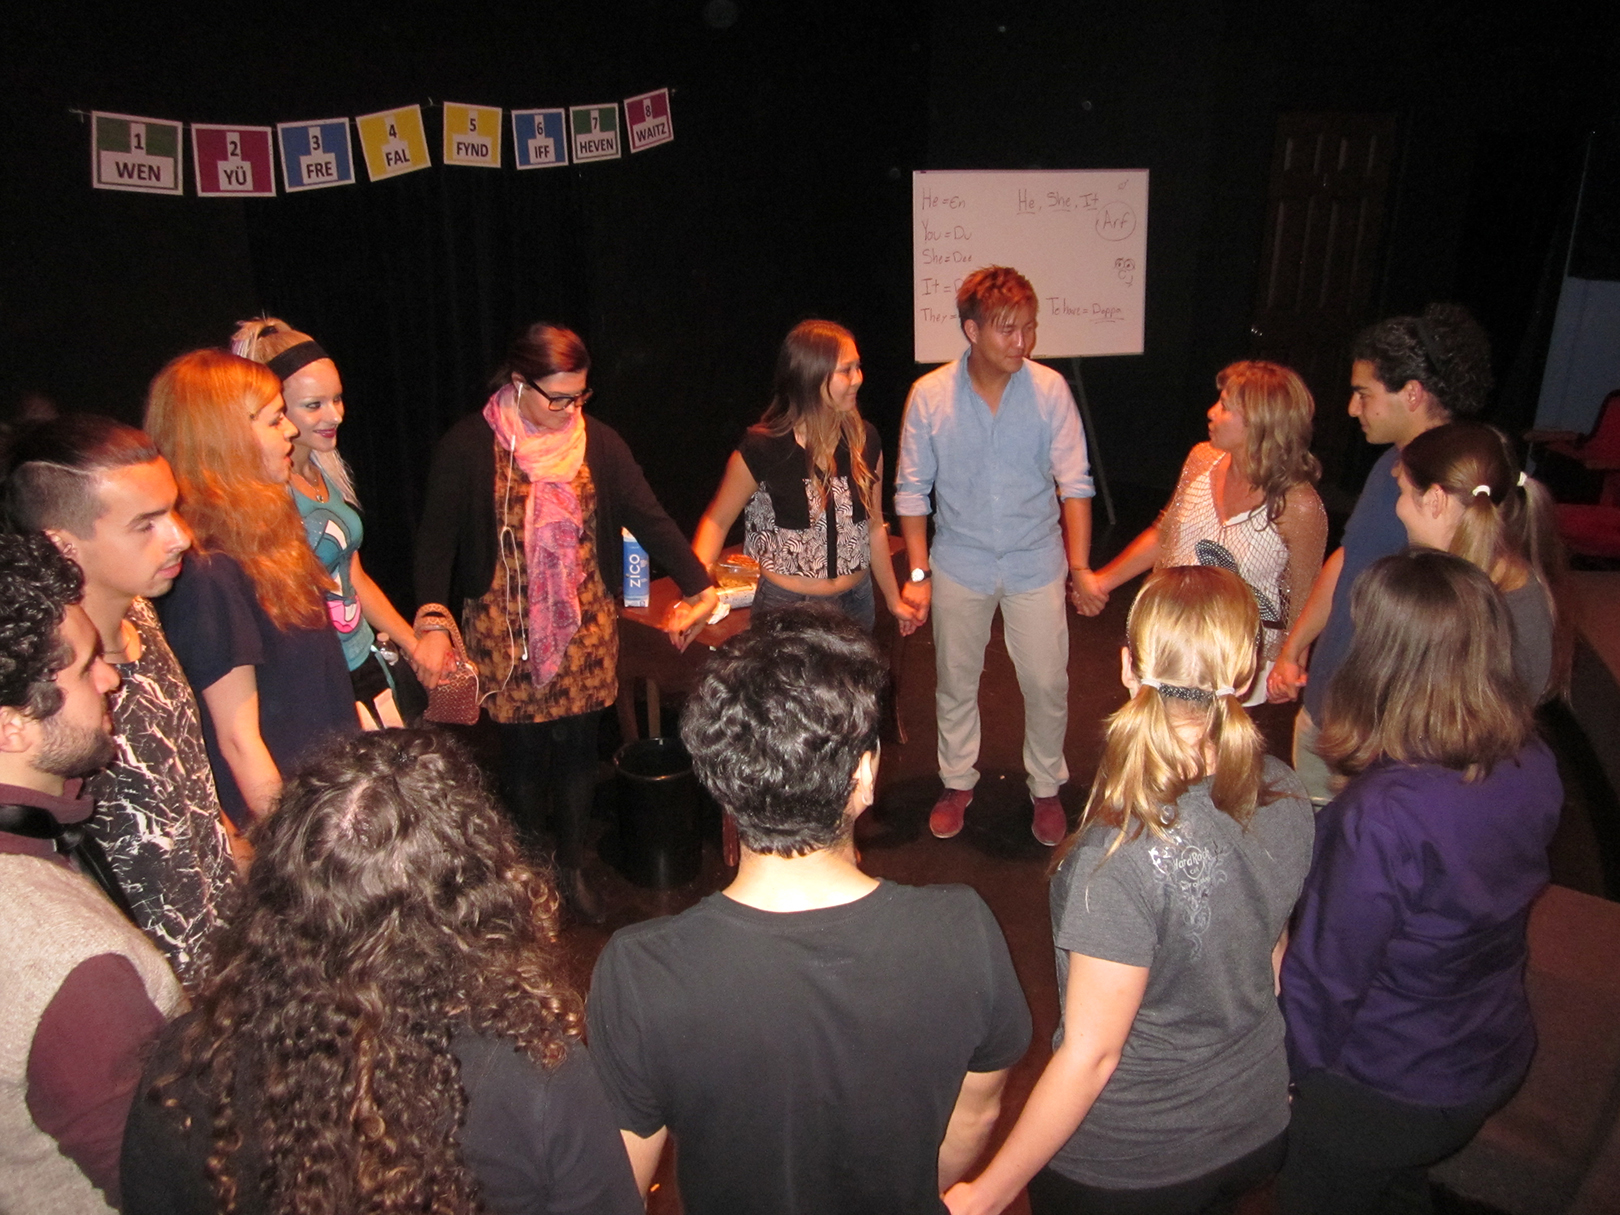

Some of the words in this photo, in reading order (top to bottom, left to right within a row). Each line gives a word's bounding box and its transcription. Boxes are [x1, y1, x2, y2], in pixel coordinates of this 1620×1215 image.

[645, 104, 652, 117] 8
[388, 123, 398, 139] 4
[469, 117, 477, 132] 5
[536, 122, 544, 136] 6
[592, 116, 599, 130] 7
[134, 132, 145, 150] 1
[636, 123, 668, 144] WAITZ
[228, 141, 240, 157] 2
[311, 135, 321, 150] 3
[456, 142, 490, 158] FYND
[579, 138, 615, 155] HEVEN
[385, 151, 411, 167] FAL
[534, 145, 551, 159] IFF
[115, 161, 162, 182] WEN
[223, 165, 248, 186] YÜ
[306, 161, 334, 179] FRE
